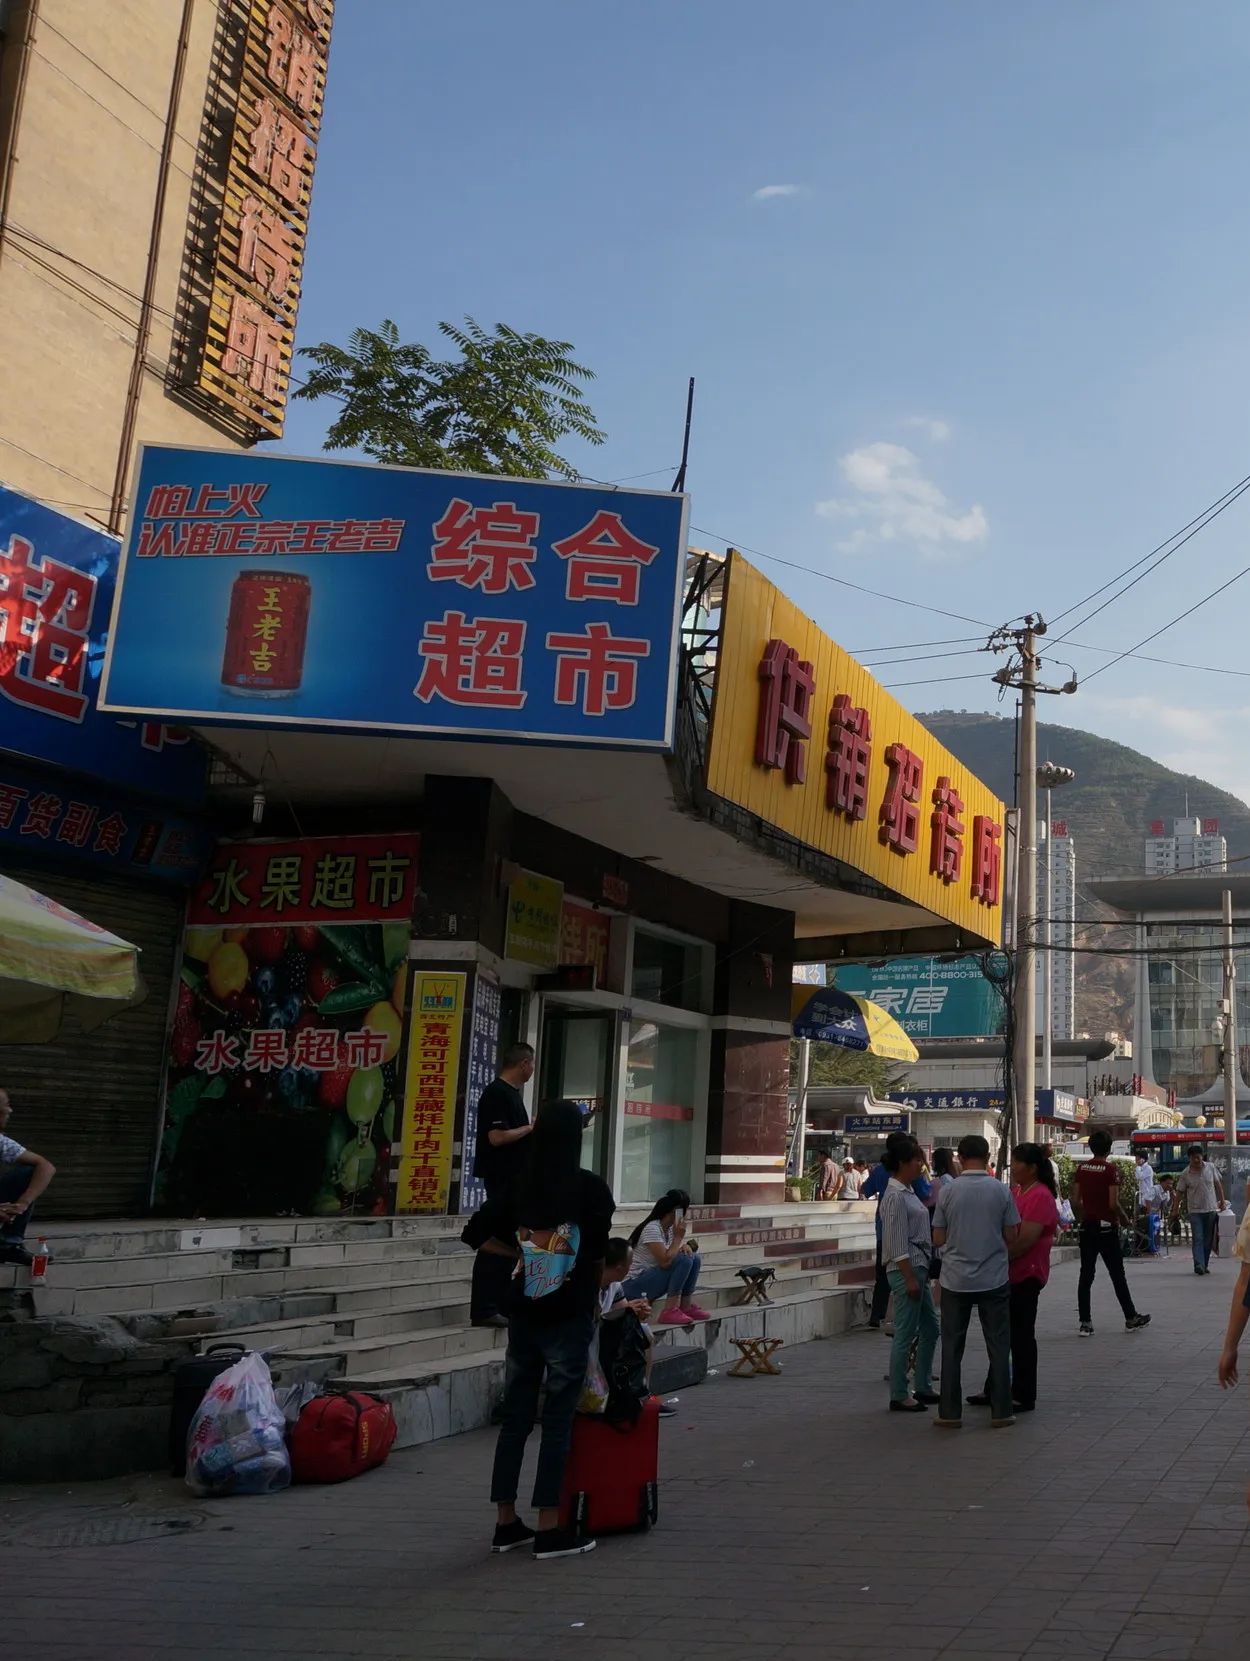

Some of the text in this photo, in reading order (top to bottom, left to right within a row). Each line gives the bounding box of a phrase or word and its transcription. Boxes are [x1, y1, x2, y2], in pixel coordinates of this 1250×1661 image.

[221, 0, 326, 401] 销招待所
[136, 517, 407, 558] 认准正宗王老吉
[144, 482, 268, 520] 怕上火
[426, 497, 661, 606] 综合
[250, 586, 284, 672] 王老吉
[412, 610, 651, 717] 超市
[755, 638, 1002, 908] 供销招待所
[0, 782, 129, 856] 百货副食
[207, 850, 412, 914] 水果超市
[847, 985, 949, 1015] 家居
[195, 1026, 390, 1075] 水果超市
[407, 1022, 451, 1204] 青海可可西里藏牦牛肉干直销点
